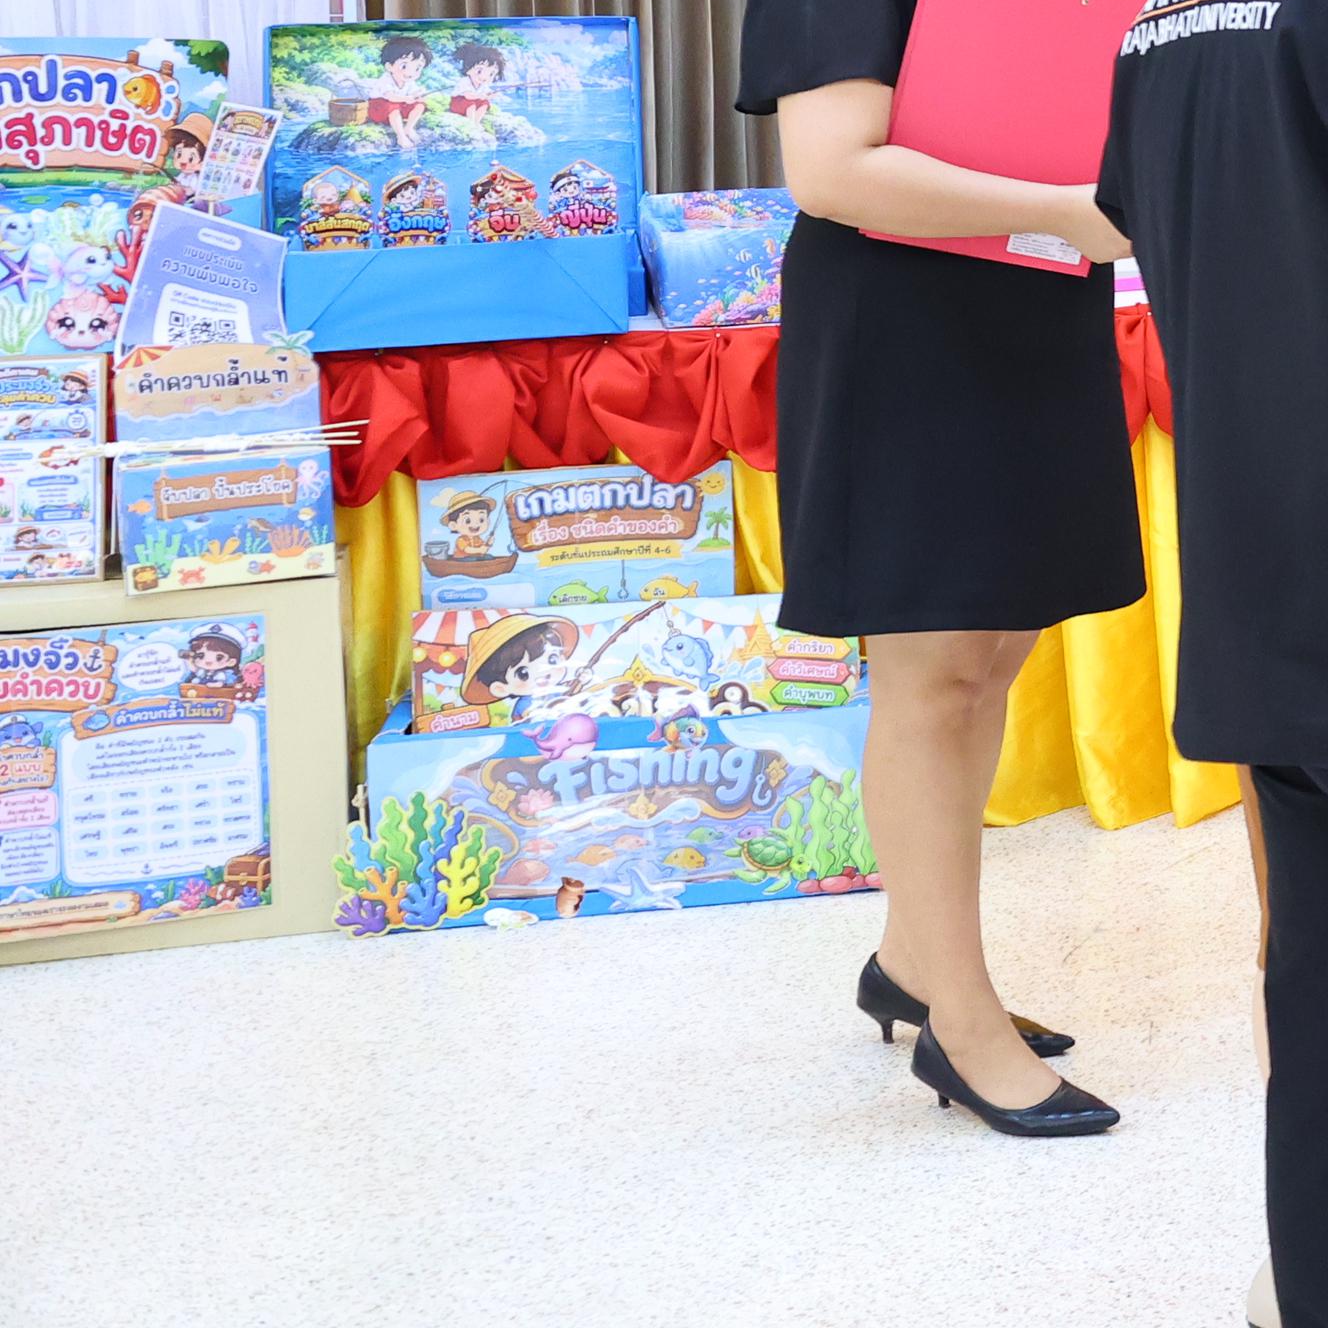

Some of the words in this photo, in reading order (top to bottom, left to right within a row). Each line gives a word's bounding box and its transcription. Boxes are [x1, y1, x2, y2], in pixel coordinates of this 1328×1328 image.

[0, 109, 157, 165] สุภาษิต
[388, 208, 446, 231] อังกฤษ
[488, 209, 522, 232] จีน
[560, 201, 609, 229] ญี่ปุ่น
[184, 246, 243, 271] แบบประเมิน
[162, 259, 258, 292] ความพึงพอใจ
[516, 474, 694, 519] เกมตกปลา
[533, 519, 568, 545] เรื่อง
[572, 515, 679, 540] ชนิดคำของคำ
[550, 544, 651, 562] ระดับชั้นประถมศึกษาปีที่
[653, 546, 672, 556] 4-6
[786, 638, 833, 654] คำกริยา
[779, 659, 837, 679] คำวิเศษณ์
[783, 685, 834, 702] คำบุพบท
[116, 700, 224, 725] คำควบกล้ำไม่แท้
[430, 710, 478, 734] คำนาม
[15, 763, 41, 774] แบบ
[539, 746, 757, 807] Fishing
